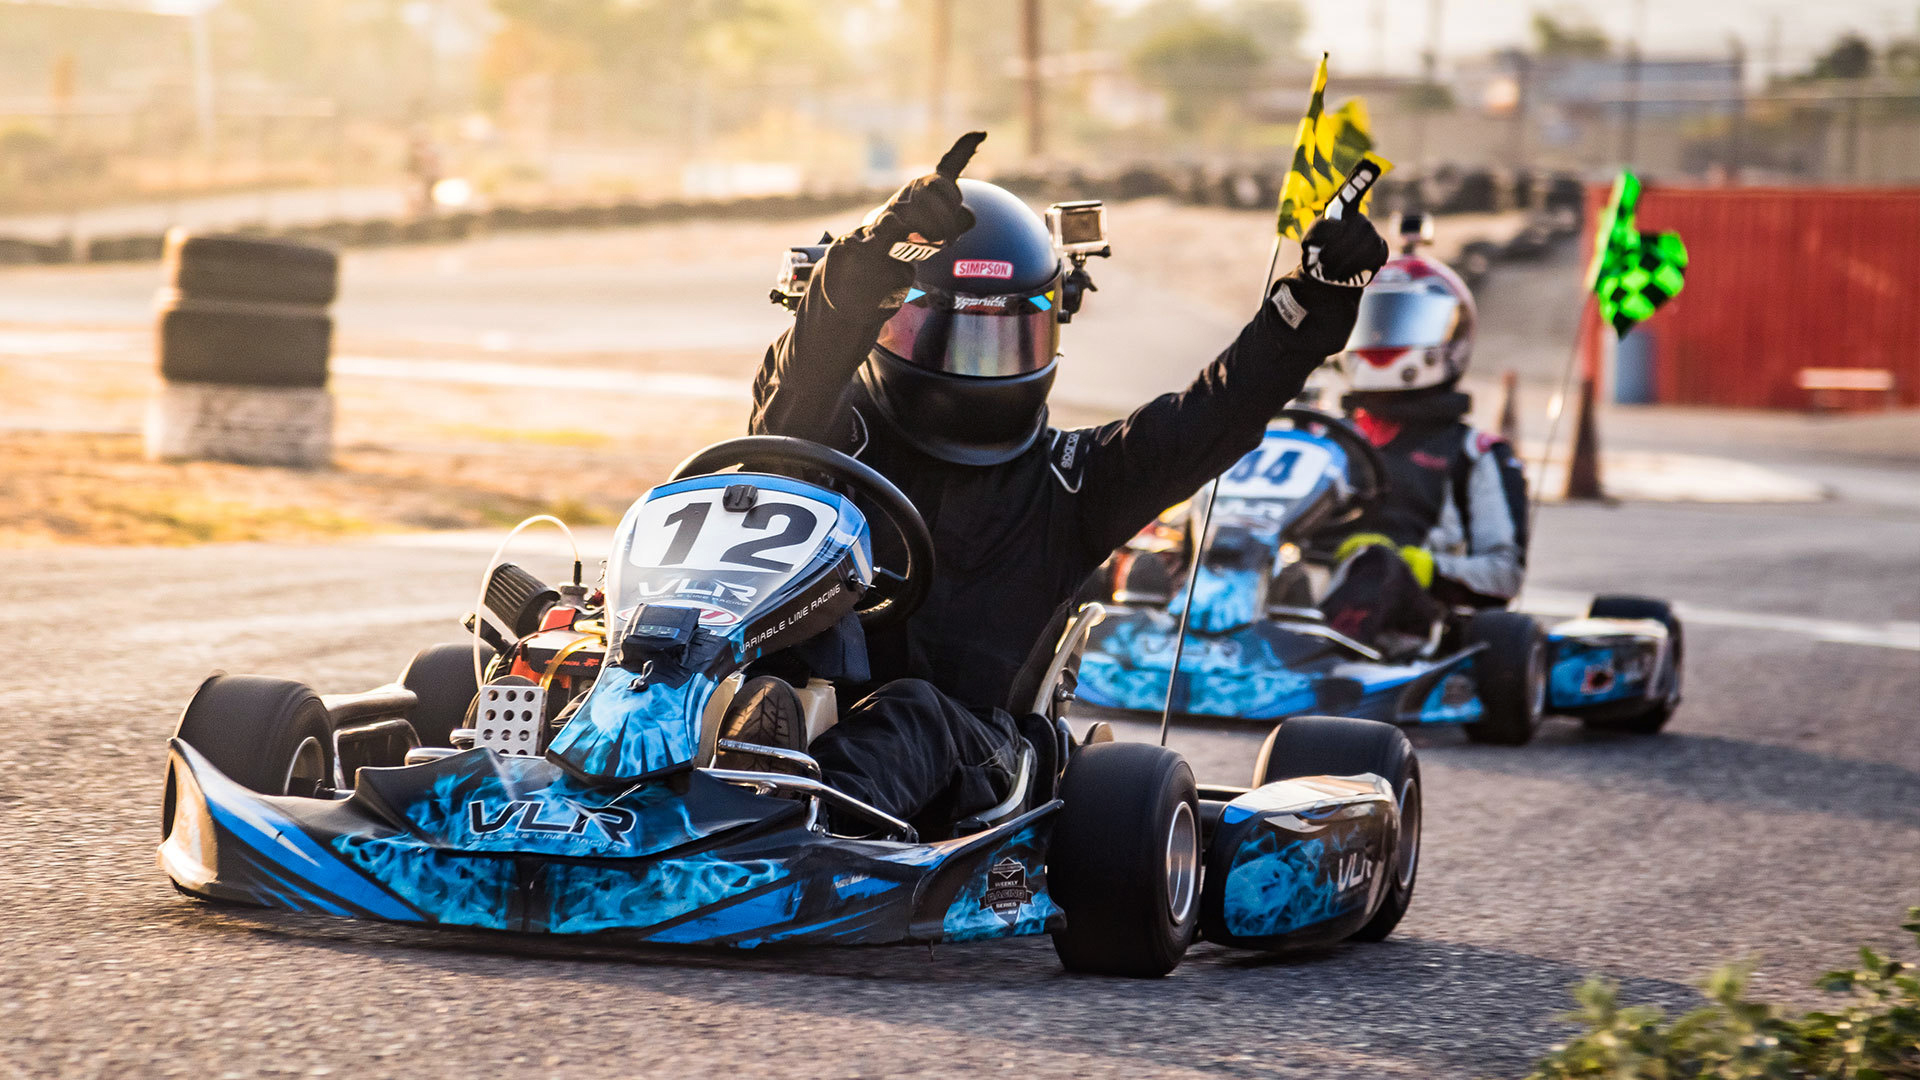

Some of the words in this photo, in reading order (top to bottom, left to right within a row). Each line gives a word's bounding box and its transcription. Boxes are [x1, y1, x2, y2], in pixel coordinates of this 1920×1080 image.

[959, 262, 1009, 275] SIMPSON
[1061, 433, 1080, 469] sparco
[1228, 450, 1302, 485] 44
[659, 501, 818, 573] 12
[638, 578, 757, 603] VLR
[739, 620, 786, 653] VARIABLE
[788, 605, 809, 625] LINE
[811, 583, 841, 611] RACING
[468, 799, 638, 848] VLR
[987, 889, 1025, 901] RACING
